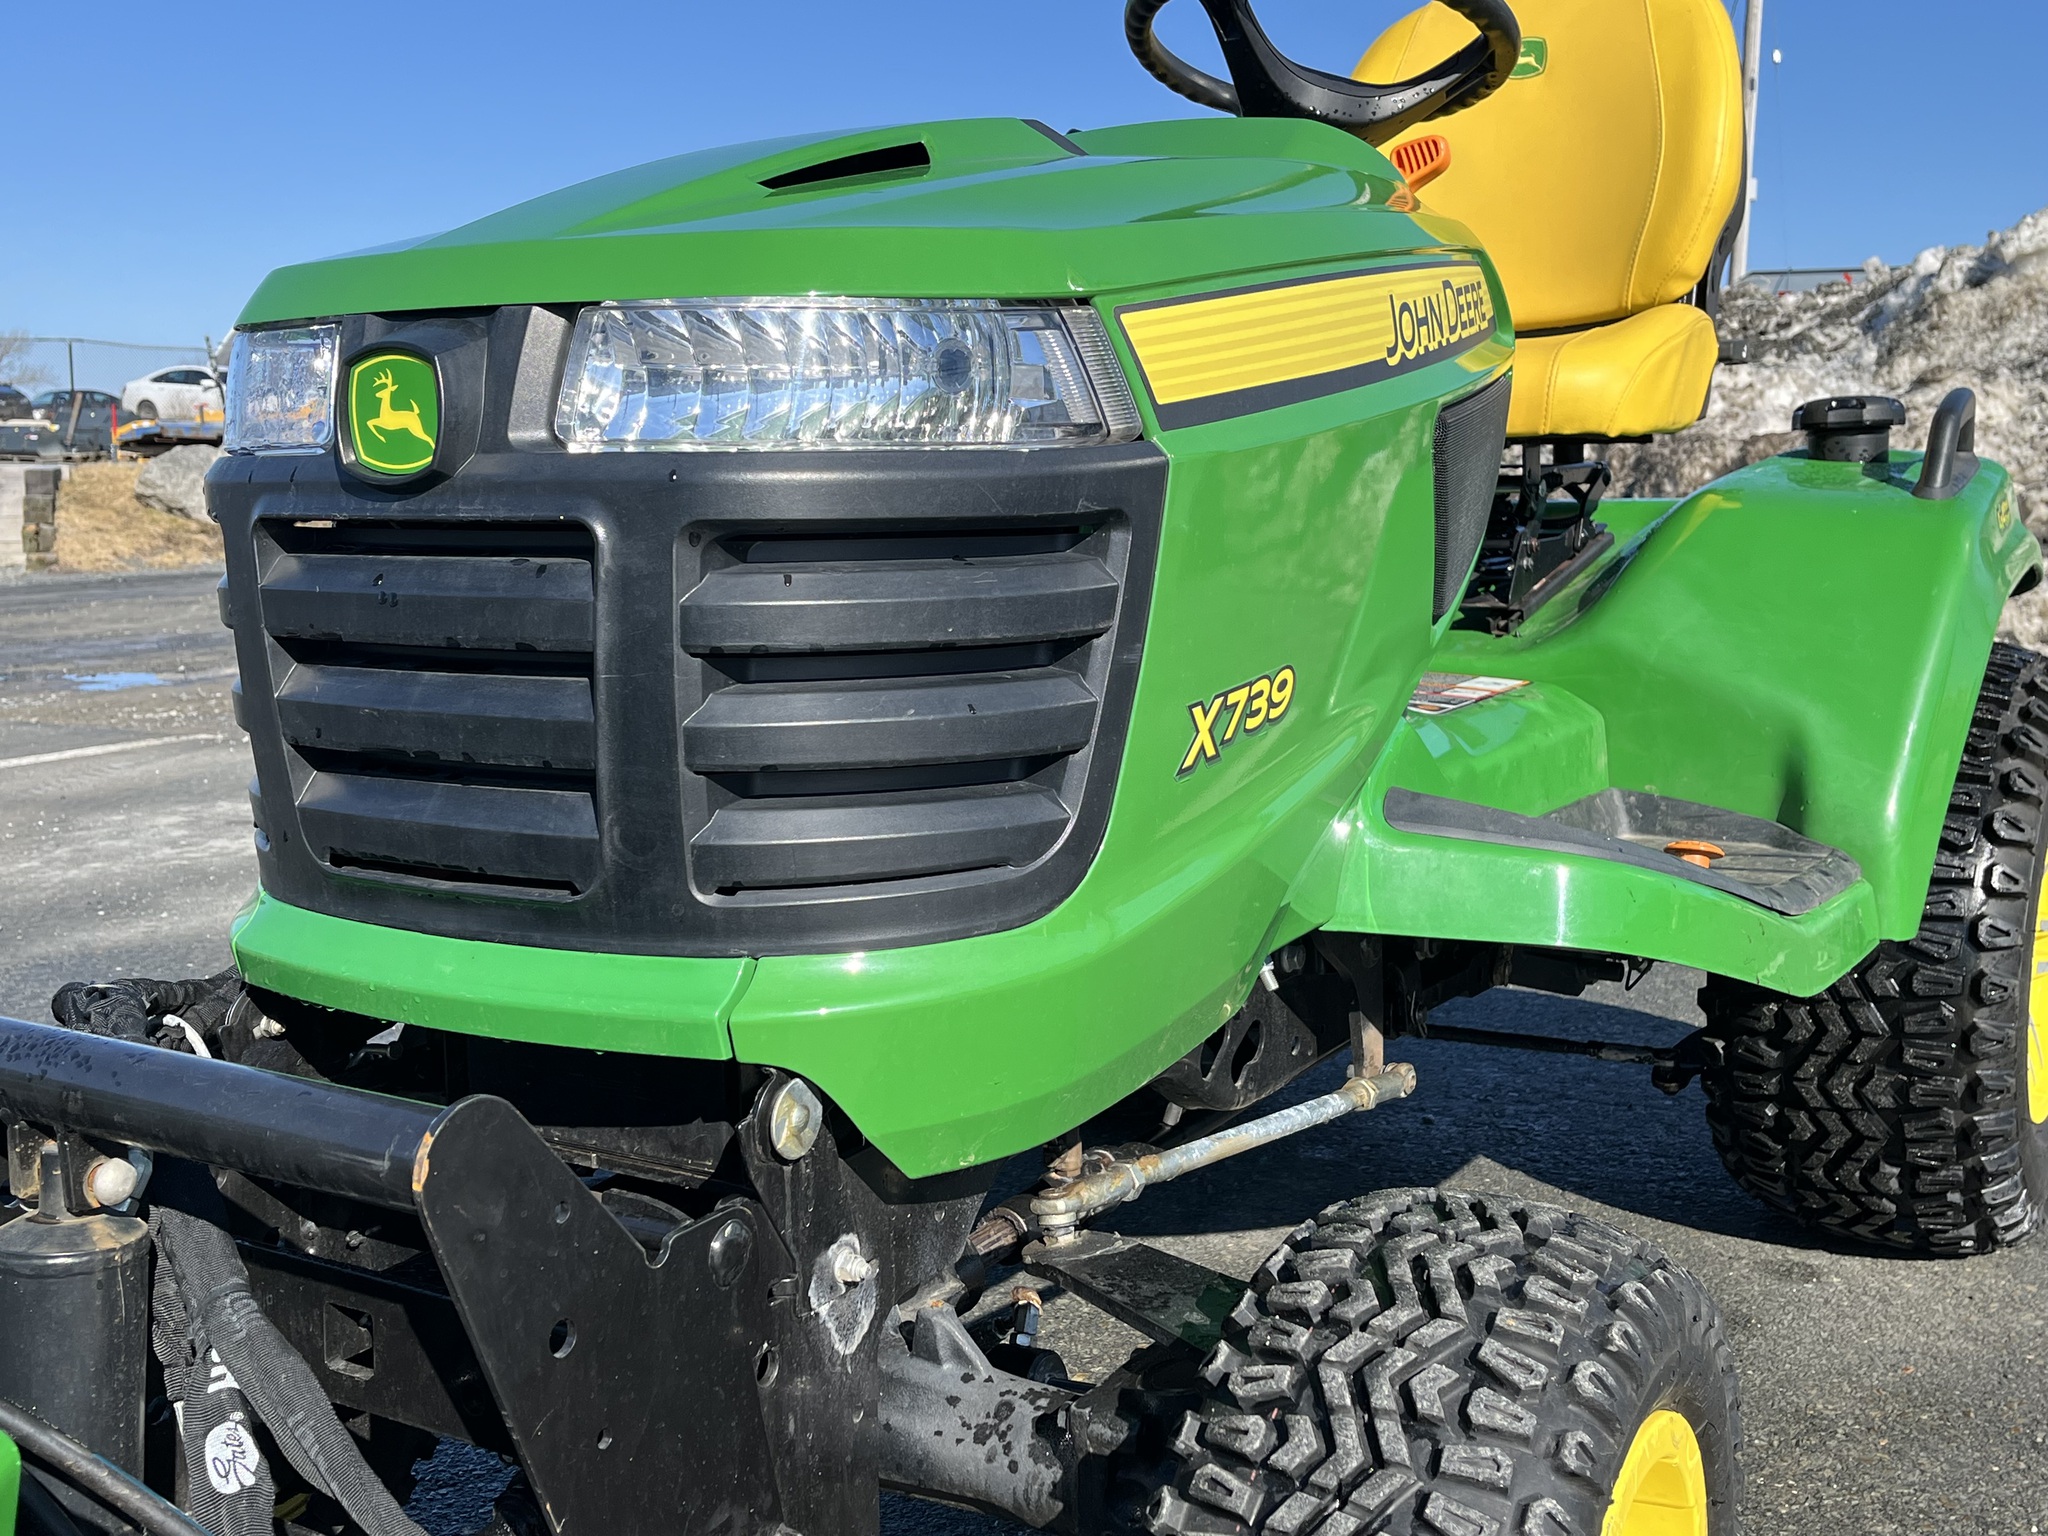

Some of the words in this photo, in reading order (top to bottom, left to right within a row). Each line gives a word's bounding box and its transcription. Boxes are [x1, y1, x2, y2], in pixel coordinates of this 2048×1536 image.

[1385, 292, 1445, 362] JOHN
[1441, 278, 1488, 340] DEERE
[1175, 664, 1296, 779] X739
